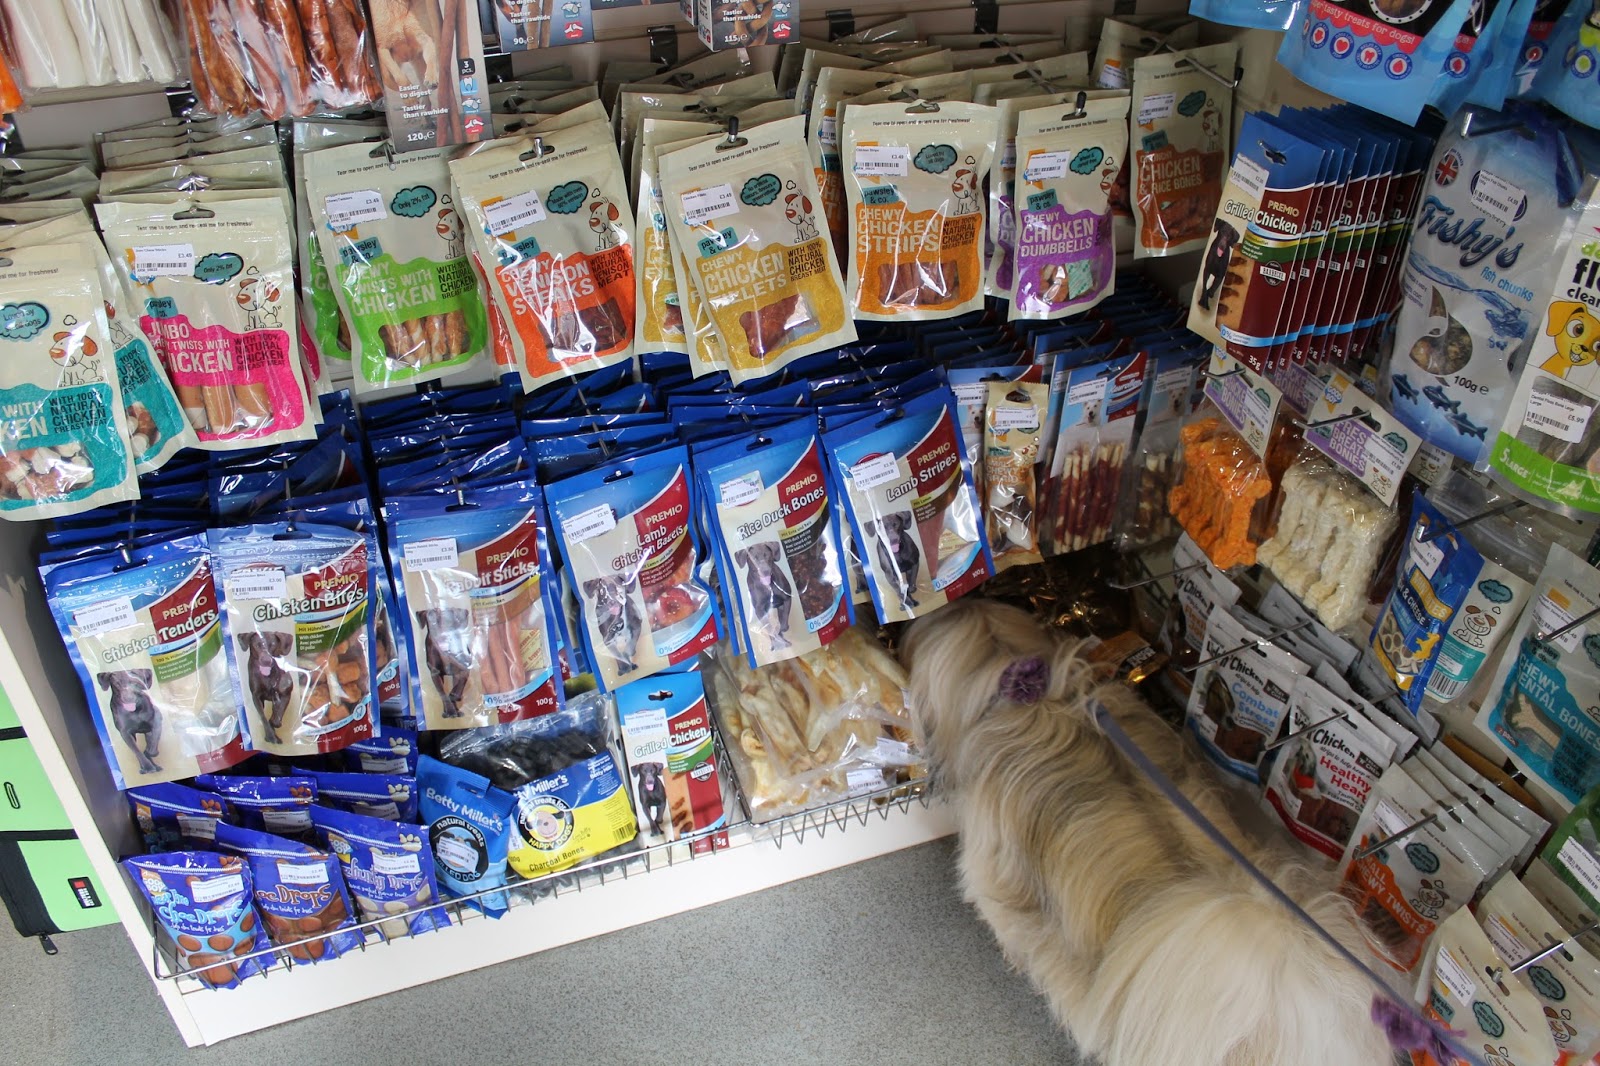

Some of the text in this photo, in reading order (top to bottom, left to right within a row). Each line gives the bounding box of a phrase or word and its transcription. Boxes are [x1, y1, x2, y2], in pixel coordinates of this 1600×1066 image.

[1344, 12, 1370, 29] treats
[1372, 24, 1388, 35] for
[1389, 30, 1415, 44] dogs!
[399, 84, 420, 92] Easier
[409, 90, 432, 98] digest
[402, 104, 425, 112] Tastier
[403, 108, 449, 119] than rawhide
[1139, 156, 1201, 182] CHICKEN
[1139, 174, 1201, 196] & RICE BONES
[859, 209, 902, 221] CHEWY
[1024, 212, 1059, 224] CHEWY
[1225, 200, 1298, 235] Grilled Chicken
[1268, 200, 1299, 217] PREMIO
[857, 219, 939, 236] CHICKEN
[943, 219, 960, 228] WITH
[943, 225, 975, 236] NATURAL
[1022, 217, 1094, 243] CHICKEN
[1418, 194, 1525, 269] Fishy's
[858, 234, 939, 254] STRIPS
[942, 232, 974, 244] CHICKEN
[1021, 237, 1093, 257] DUMBBELLS
[787, 241, 822, 258] WITH 100%
[788, 251, 823, 266] NATURAL
[437, 264, 456, 274] WITH
[590, 254, 607, 266] WITH
[591, 256, 627, 273] NATURAL
[702, 251, 742, 273] CHEWY
[789, 258, 825, 276] CHICKEN
[400, 269, 432, 287] WITH
[438, 269, 471, 284] NATURAL
[505, 260, 588, 297] VENISON
[595, 263, 629, 280] VENISON
[598, 270, 629, 288] MEAT
[704, 251, 784, 294] CHICKEN
[790, 271, 813, 282] BREAST
[440, 276, 474, 293] CHICKEN
[1480, 265, 1534, 302] fish chunks
[352, 283, 437, 316] CHICKEN
[513, 277, 594, 315] STEAKS
[148, 322, 190, 339] JUMBO
[234, 333, 281, 344] WITH 100%
[172, 339, 230, 351] TWISTS WITH
[235, 341, 281, 354] NATURAL
[156, 349, 234, 374] CHICKEN
[236, 350, 284, 364] CHICKEN
[1248, 354, 1261, 371] 35g
[1453, 375, 1478, 393] 100g
[2, 401, 44, 418] WITH
[51, 395, 74, 407] WITH
[51, 401, 105, 417] NATURAL
[52, 409, 107, 426] CHICKEN
[1568, 415, 1584, 424] £5.99
[1332, 427, 1363, 455] BREAT
[1336, 419, 1367, 445] FRES
[917, 442, 950, 467] PREMIO
[1329, 438, 1366, 471] BONIES
[886, 475, 918, 502] Lamb
[920, 452, 957, 483] Stripes
[1506, 457, 1529, 479] LARGE
[785, 473, 818, 495] PREMIO
[645, 503, 682, 526] PREMIO
[737, 485, 825, 540] Rice Duck Bones
[636, 525, 667, 547] Lamb
[486, 547, 529, 565] PREMIO
[612, 525, 684, 571] Chicken Bagels
[493, 560, 537, 583] Sticks
[314, 573, 359, 591] PREMIO
[935, 578, 947, 589] 0%
[163, 595, 208, 621] PREMIO
[253, 587, 364, 623] Chicken Bites
[1402, 588, 1426, 625] & CHEESE
[809, 620, 822, 629] 0%
[102, 608, 216, 664] Chicken Tenders
[700, 632, 714, 643] 100g
[659, 644, 672, 655] 0%
[1229, 657, 1263, 686] Chicken
[1518, 654, 1560, 695] CHEWY
[384, 682, 400, 692] 100g
[536, 697, 553, 706] 100g
[1232, 682, 1279, 719] Combat
[675, 717, 702, 730] PREMIO
[1239, 702, 1276, 728] Stress
[353, 723, 367, 734] 100g
[634, 726, 707, 758] Grilled Chicken
[1313, 729, 1356, 758] Chicken
[1320, 756, 1372, 793] Healthy
[531, 775, 568, 795] Miller's
[1331, 775, 1367, 803] Heart
[426, 788, 503, 832] Betty Miller's
[535, 798, 567, 809] treats for
[437, 818, 484, 847] natural treats
[528, 825, 572, 849] HAPPY DOGS
[529, 846, 585, 872] Charcoal Bones
[387, 872, 423, 891] Drops
[276, 884, 331, 908] Drops
[1386, 894, 1426, 934] TWISTS
